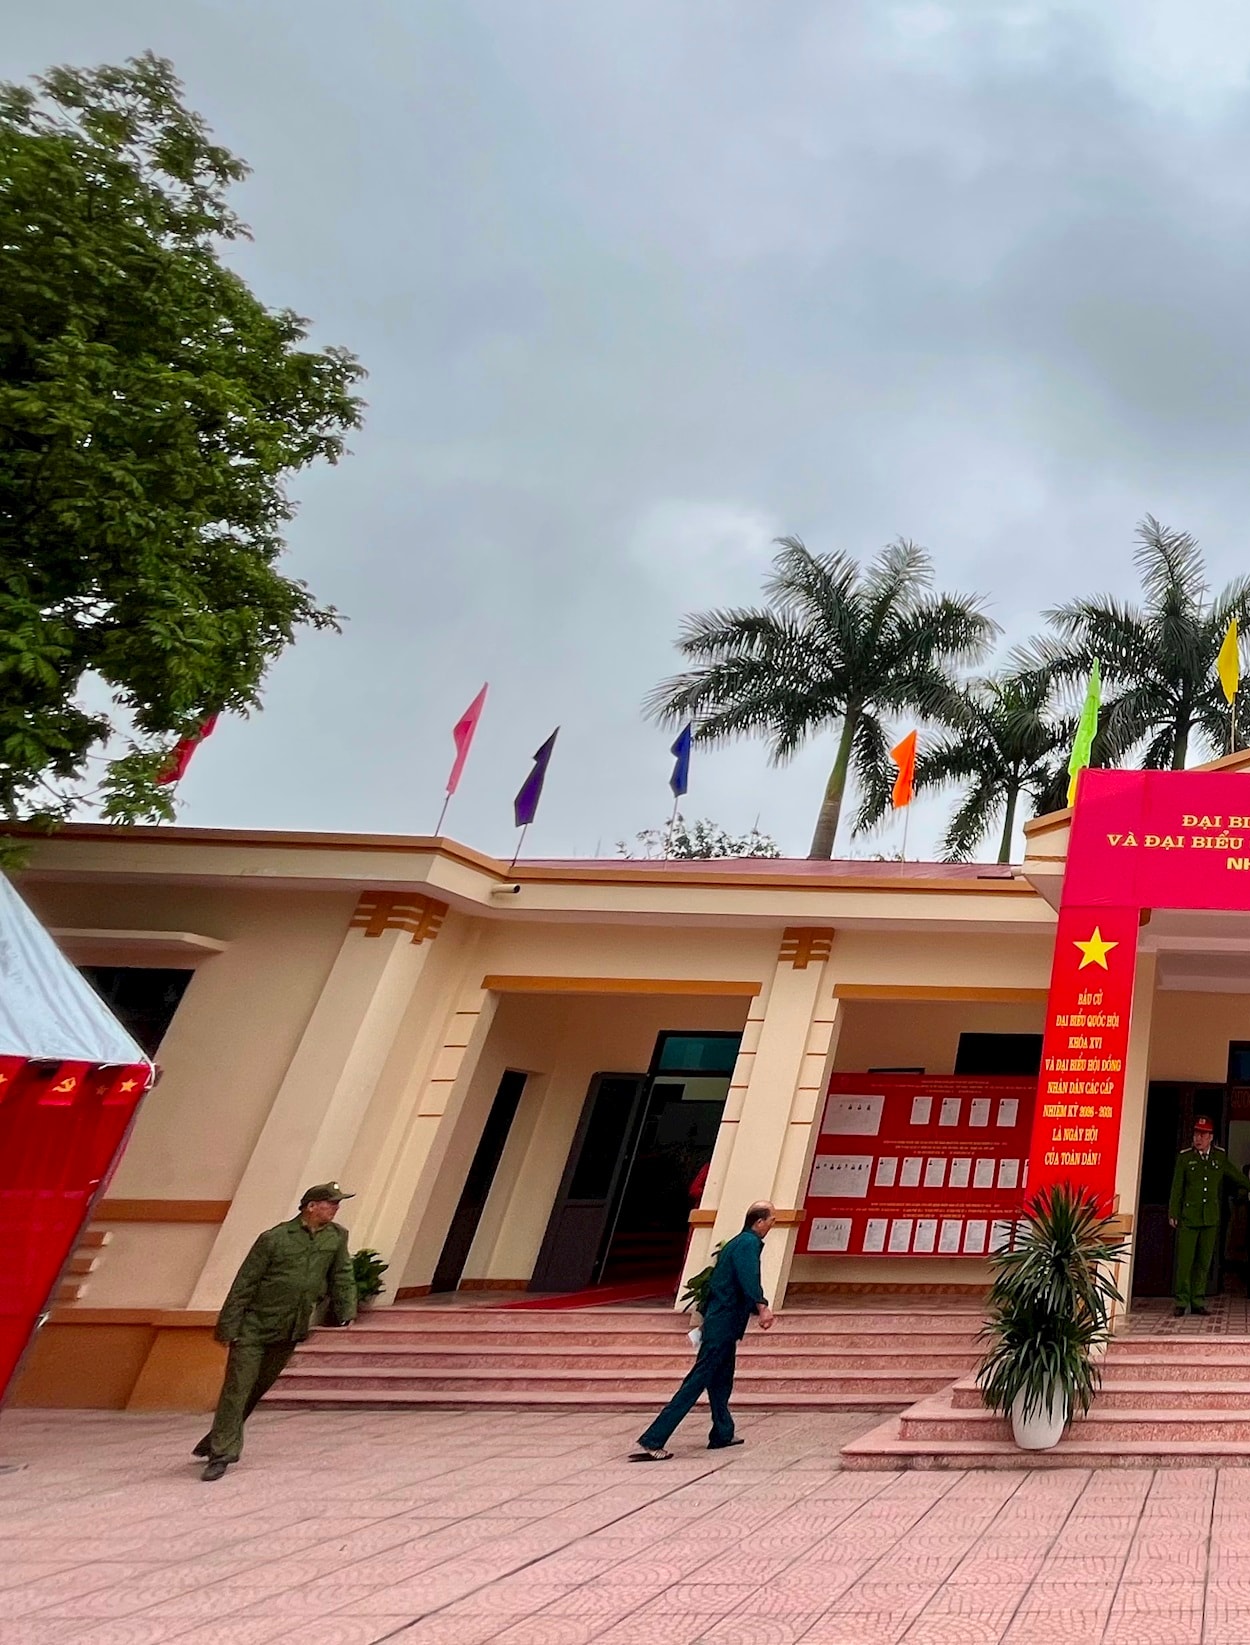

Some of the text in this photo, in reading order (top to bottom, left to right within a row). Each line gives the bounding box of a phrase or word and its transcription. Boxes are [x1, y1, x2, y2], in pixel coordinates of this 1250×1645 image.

[1182, 814, 1222, 830] ĐẠI
[1107, 831, 1138, 847] VÀ
[1144, 835, 1185, 850] ĐẠI
[1191, 830, 1244, 850] BIỂU
[1089, 1037, 1103, 1049] XVI
